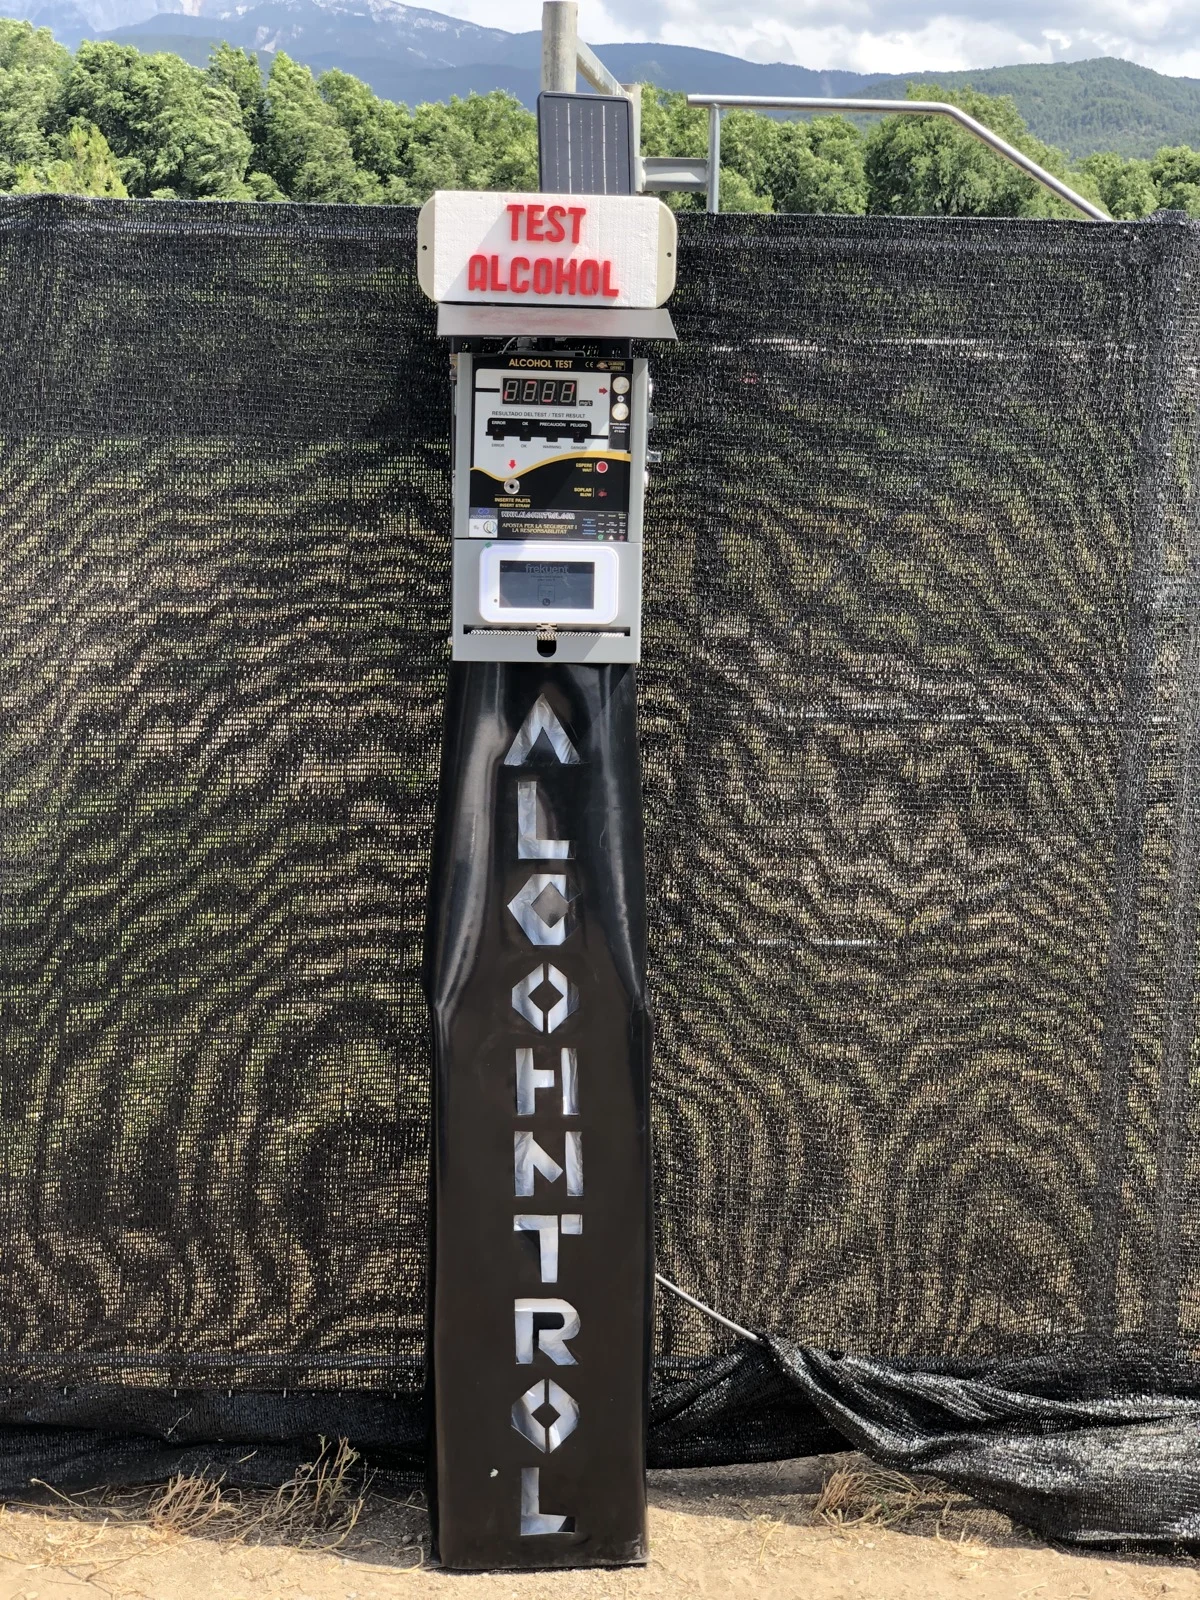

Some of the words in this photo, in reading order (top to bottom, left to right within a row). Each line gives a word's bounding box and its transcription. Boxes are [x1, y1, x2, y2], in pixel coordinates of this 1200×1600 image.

[507, 204, 586, 244] TEST
[468, 254, 619, 297] ALCOHOL
[508, 358, 552, 368] ALCOHOL
[555, 359, 573, 369] TEST
[525, 563, 569, 574] frekuent
